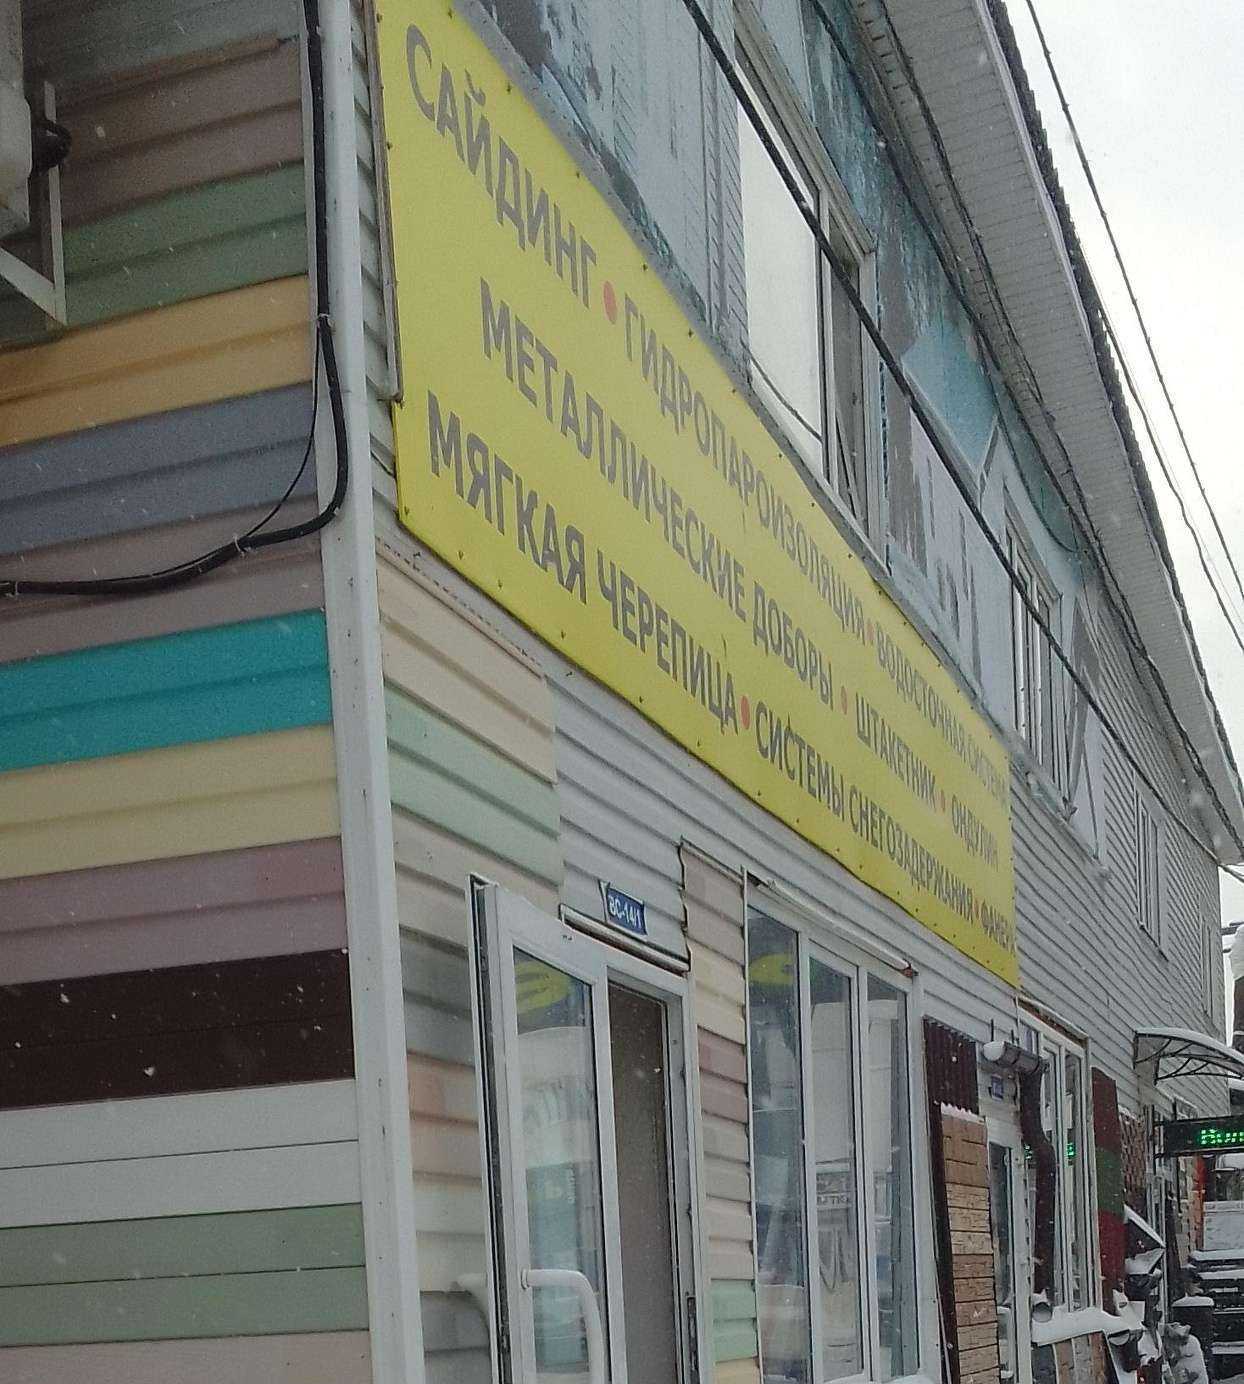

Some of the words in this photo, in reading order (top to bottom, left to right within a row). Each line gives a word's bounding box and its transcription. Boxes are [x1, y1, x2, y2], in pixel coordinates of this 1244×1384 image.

[406, 24, 596, 308] САЙДИНГ
[625, 293, 866, 646] ГИДРОПАРОИЗОЛЯЦИЯ
[876, 621, 966, 764] ВОДОСТОЧНАЯ
[428, 390, 587, 604] МЯГКАЯ
[597, 548, 739, 737] ЧЕРЕПИЦА
[755, 701, 844, 822] СИСТЕМЫ
[850, 784, 973, 925] СНЕГОЗАДЕРЖАНИЯ
[480, 277, 747, 623] МЕТАЛЛИЧЕСКИЕ
[752, 580, 834, 711] ДОБОРЫ
[855, 692, 936, 813] ШТАКЕТНИК
[952, 794, 998, 872] ОНДУЛИН
